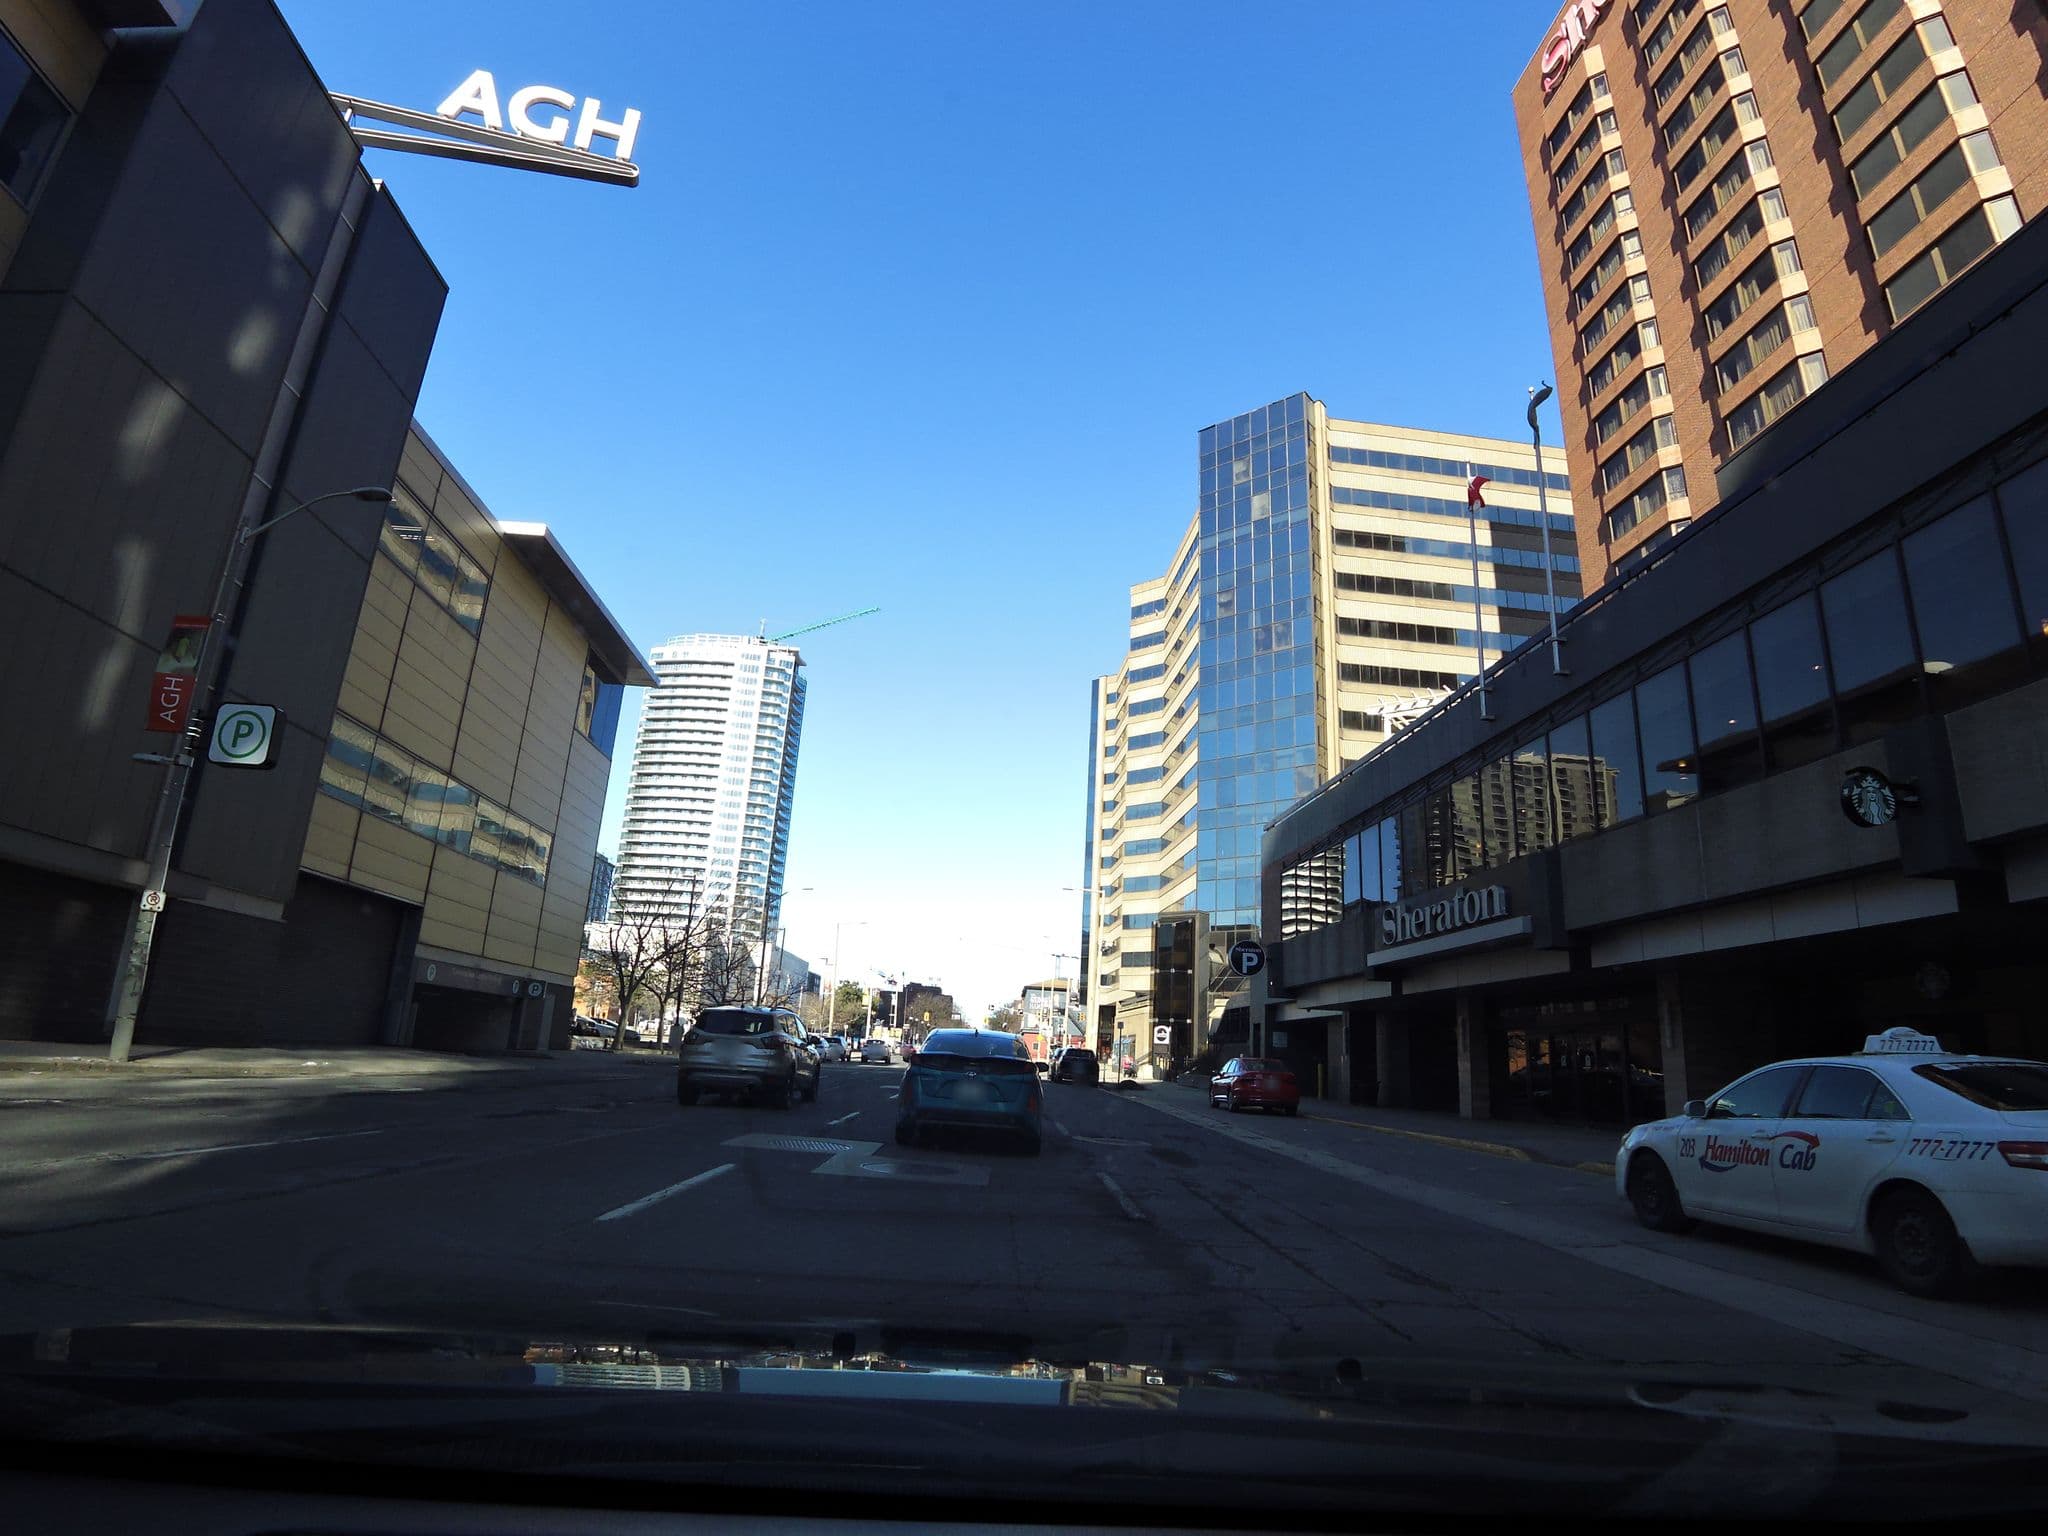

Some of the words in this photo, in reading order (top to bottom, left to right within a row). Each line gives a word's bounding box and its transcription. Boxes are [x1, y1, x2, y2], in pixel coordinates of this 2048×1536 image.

[1541, 0, 1607, 92] Sh
[436, 69, 641, 161] AGH
[160, 676, 184, 724] AGH
[231, 720, 254, 748] P
[1382, 884, 1509, 945] Sheraton
[1242, 952, 1258, 974] P
[1880, 1039, 1935, 1052] 777-7777
[1680, 1138, 1696, 1158] 203
[1704, 1135, 1770, 1166] Hamilton
[1780, 1144, 1817, 1171] Cab
[1908, 1138, 1997, 1161] 777-7777
